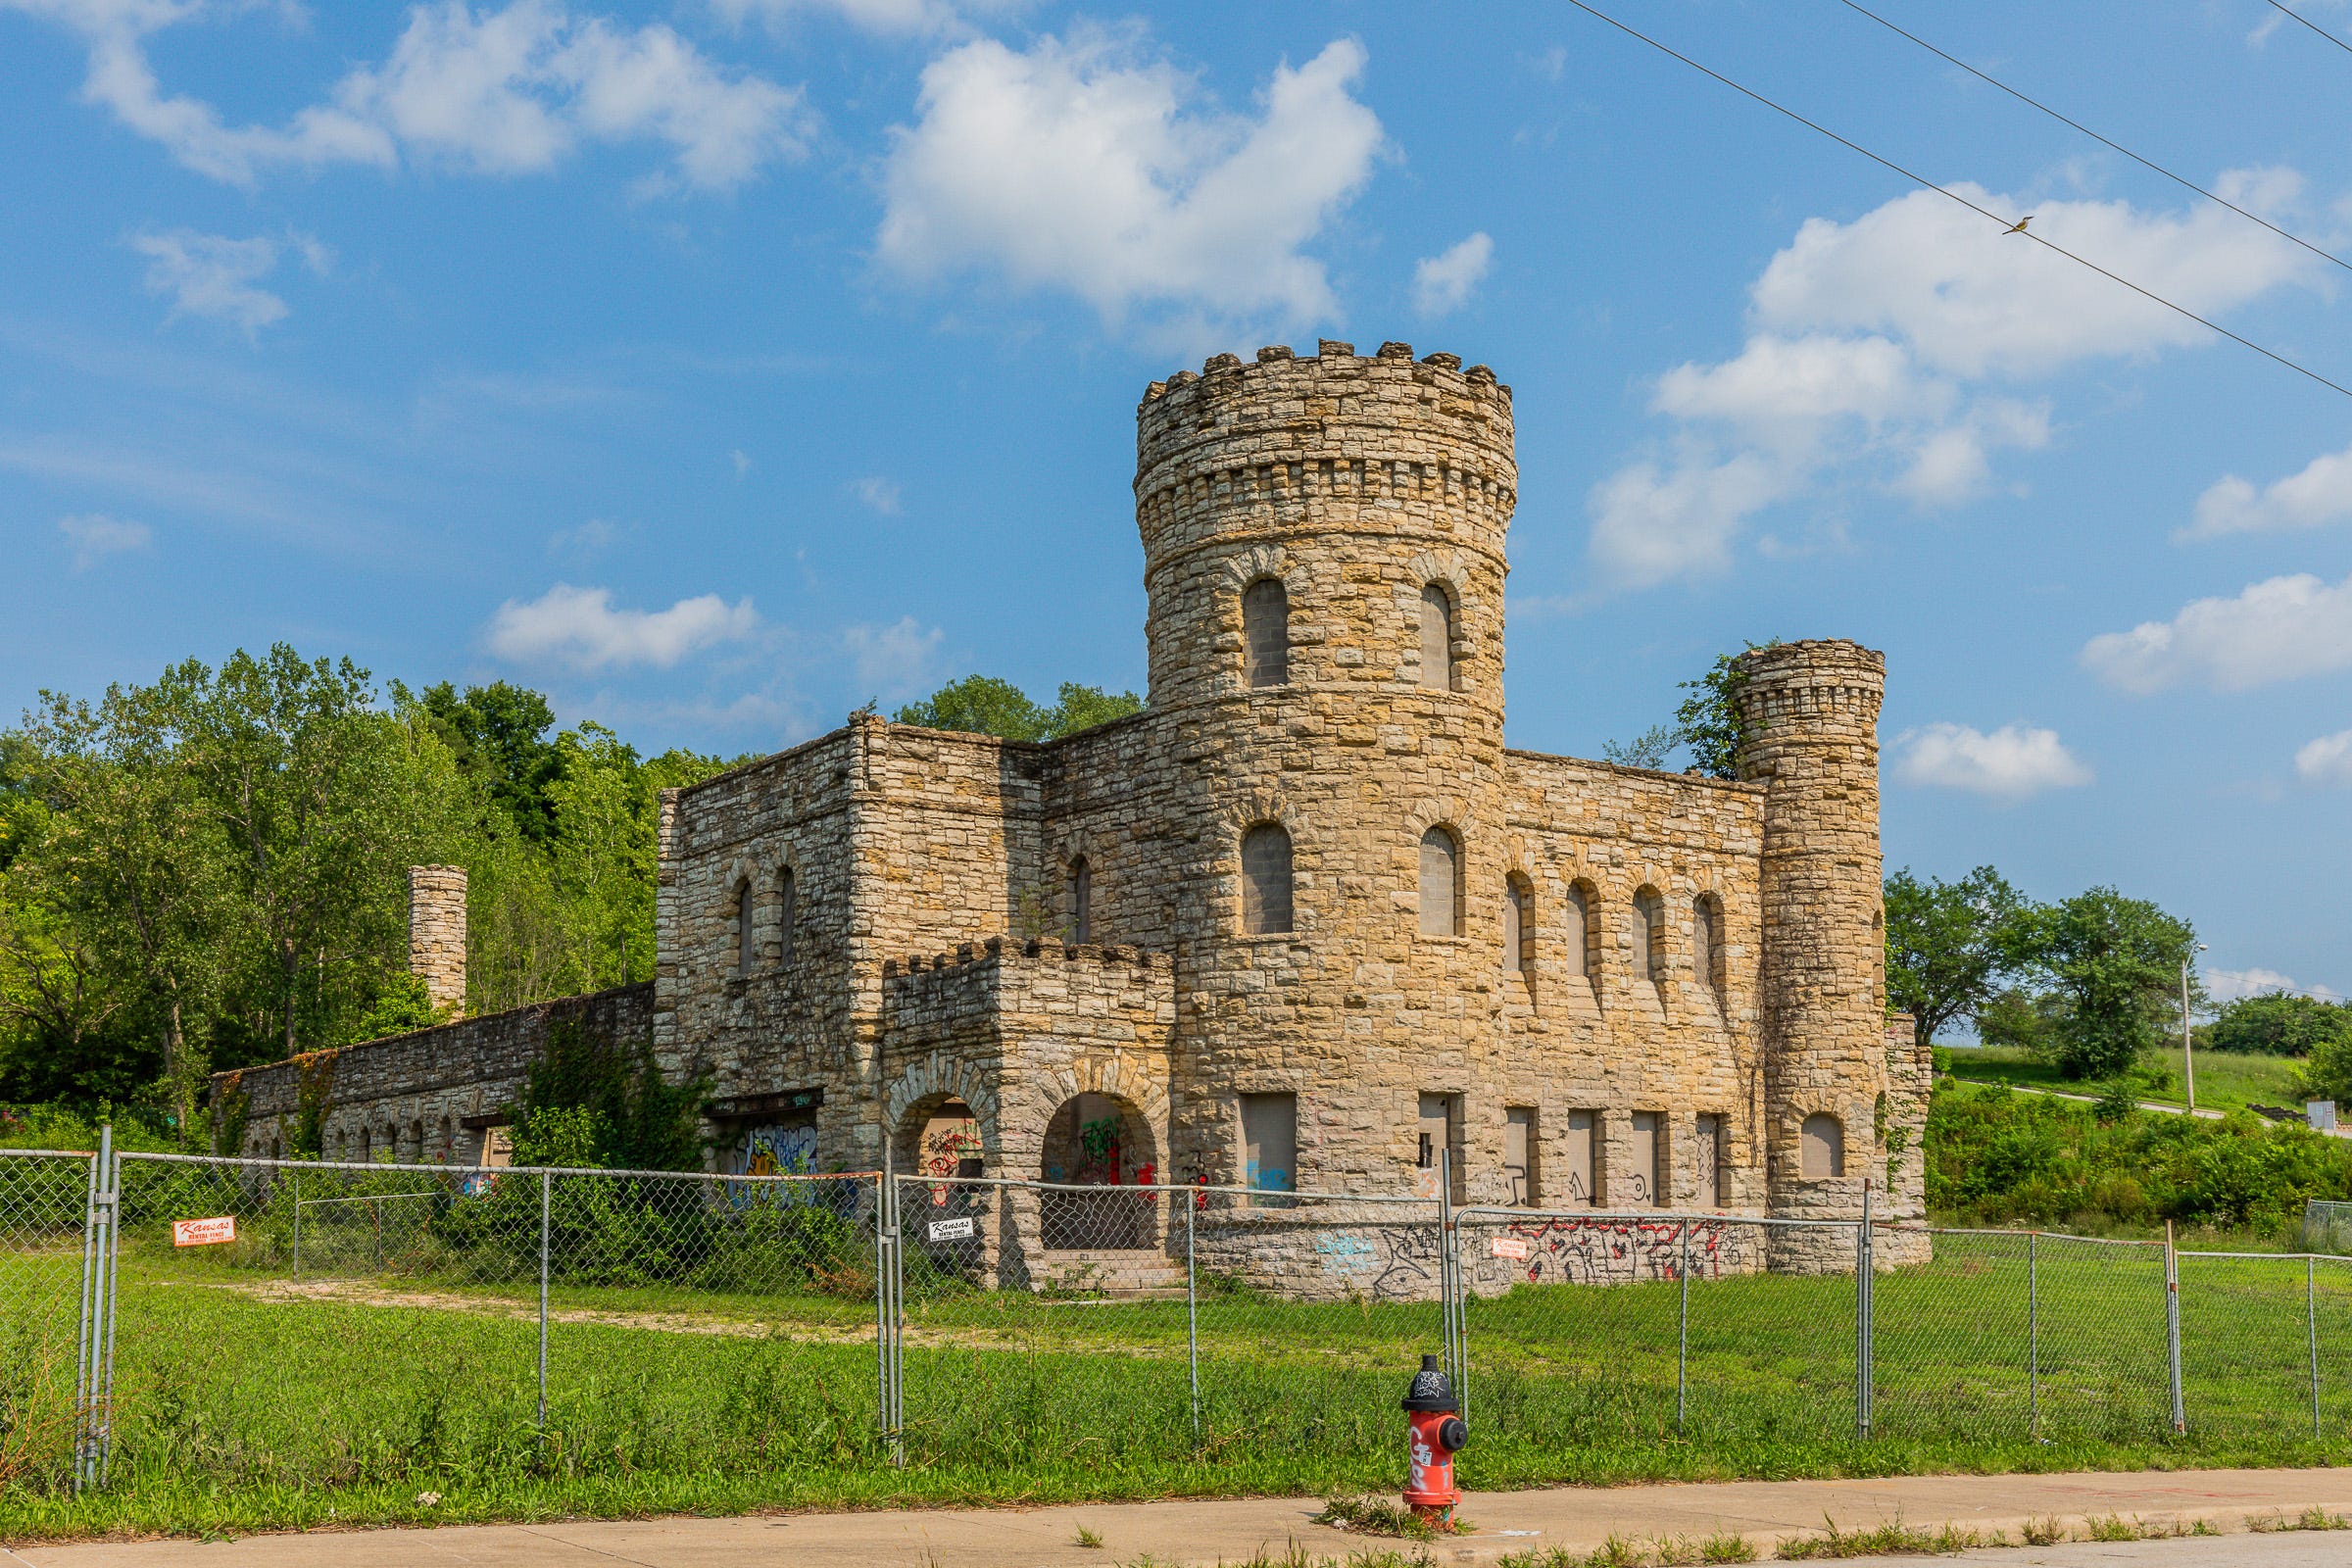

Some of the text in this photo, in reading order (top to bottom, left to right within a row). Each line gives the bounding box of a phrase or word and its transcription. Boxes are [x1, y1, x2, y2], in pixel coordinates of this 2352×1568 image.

[179, 1221, 229, 1235] Kansas
[932, 1221, 969, 1233] Kansas
[1495, 1239, 1524, 1250] Kansas
